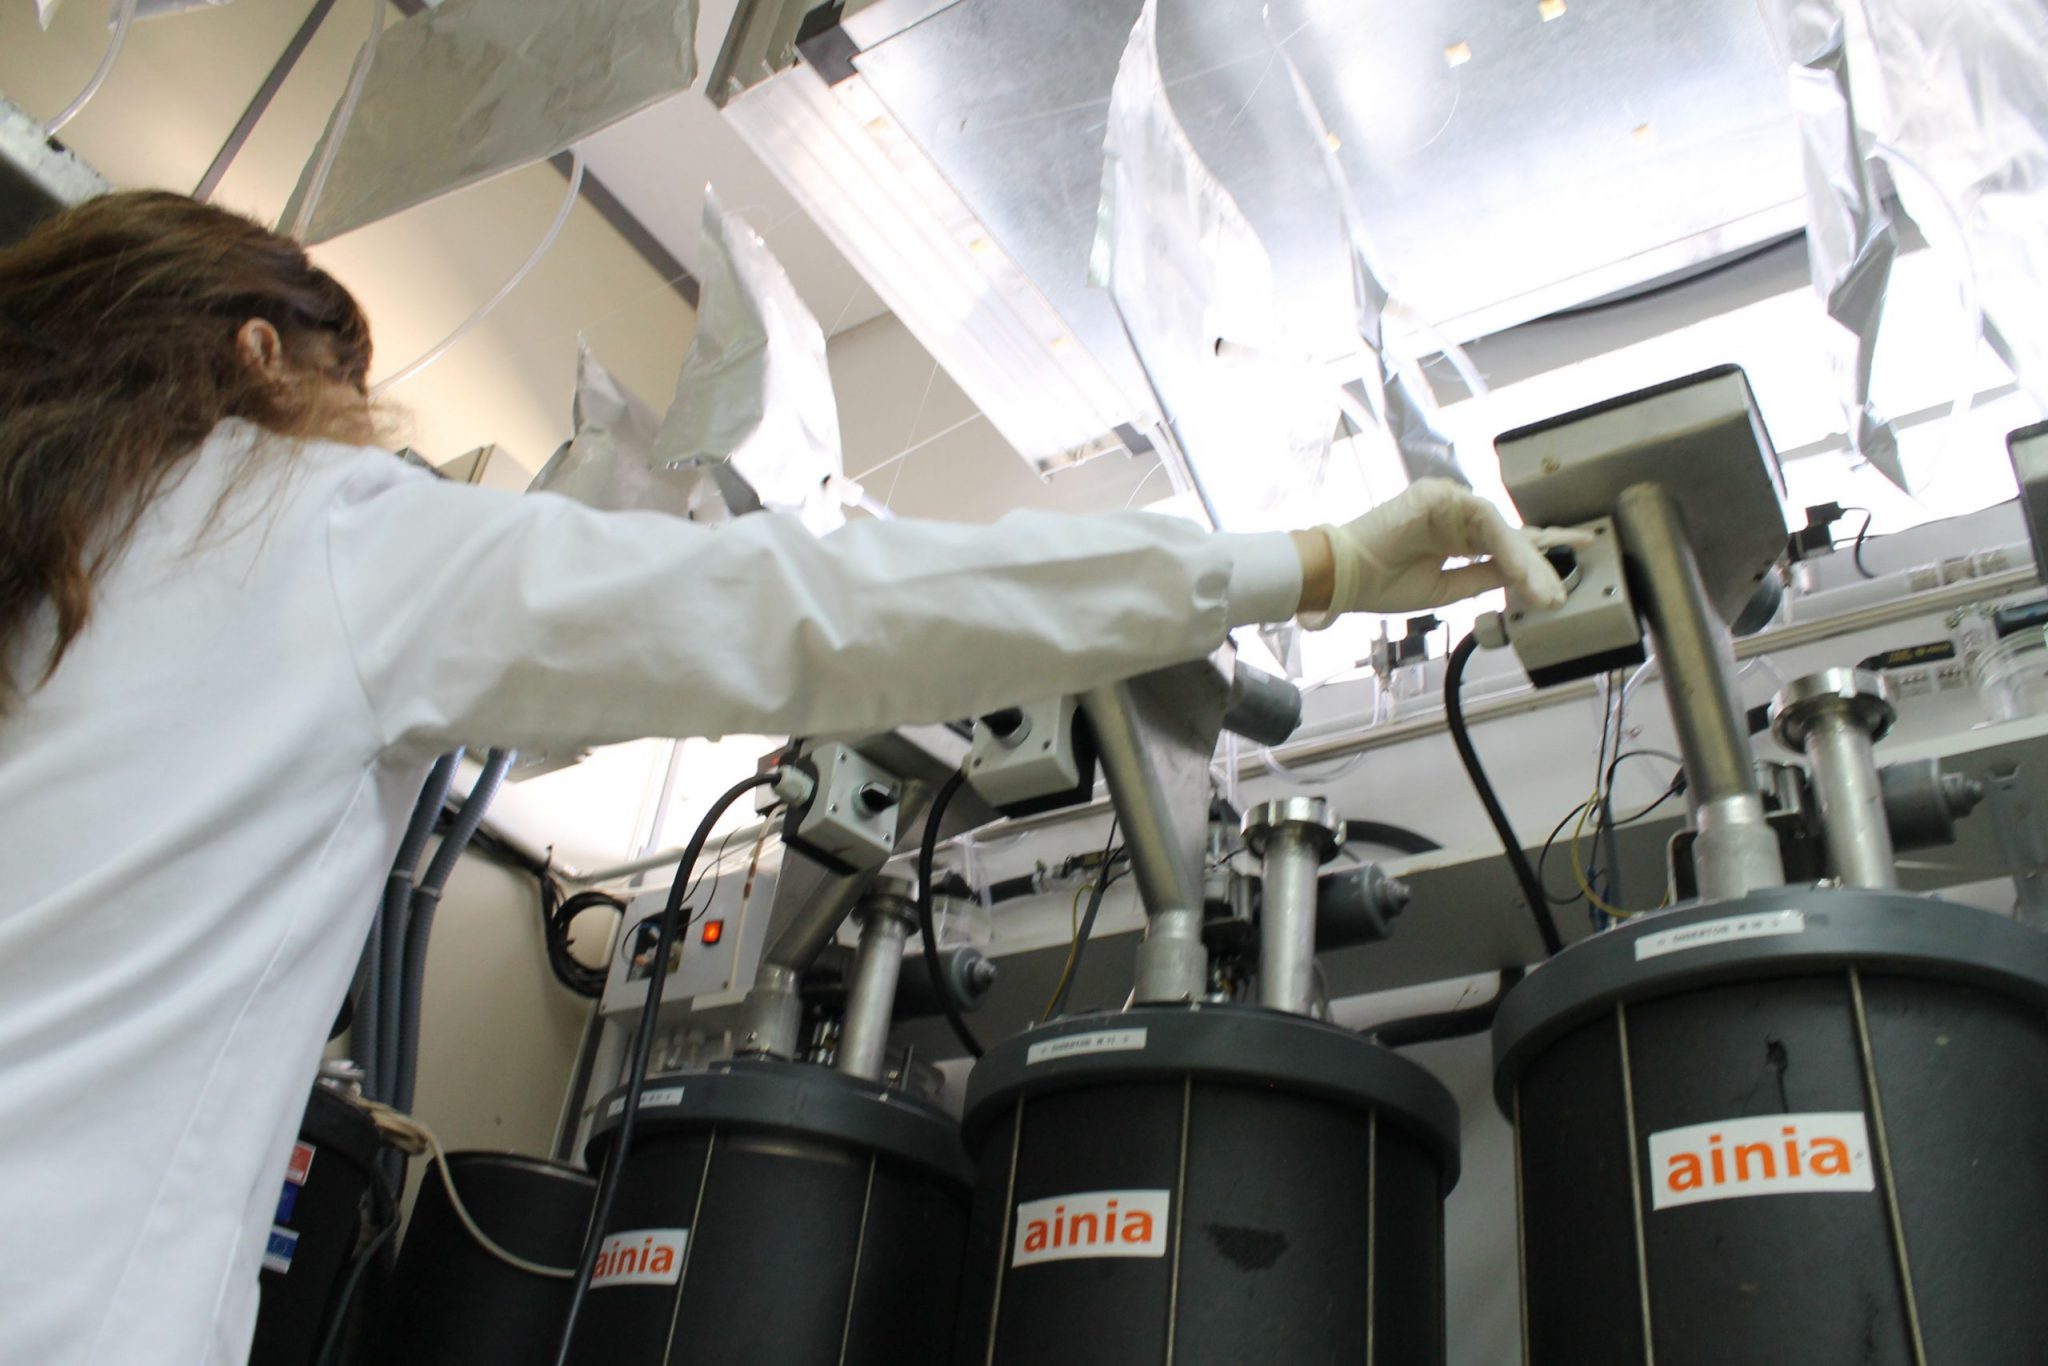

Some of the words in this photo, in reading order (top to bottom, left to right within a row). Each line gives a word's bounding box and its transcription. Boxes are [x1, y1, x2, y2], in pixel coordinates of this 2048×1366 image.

[1667, 1126, 1852, 1193] ainia
[1024, 1199, 1153, 1253] ainia
[592, 1236, 674, 1278] ainia
